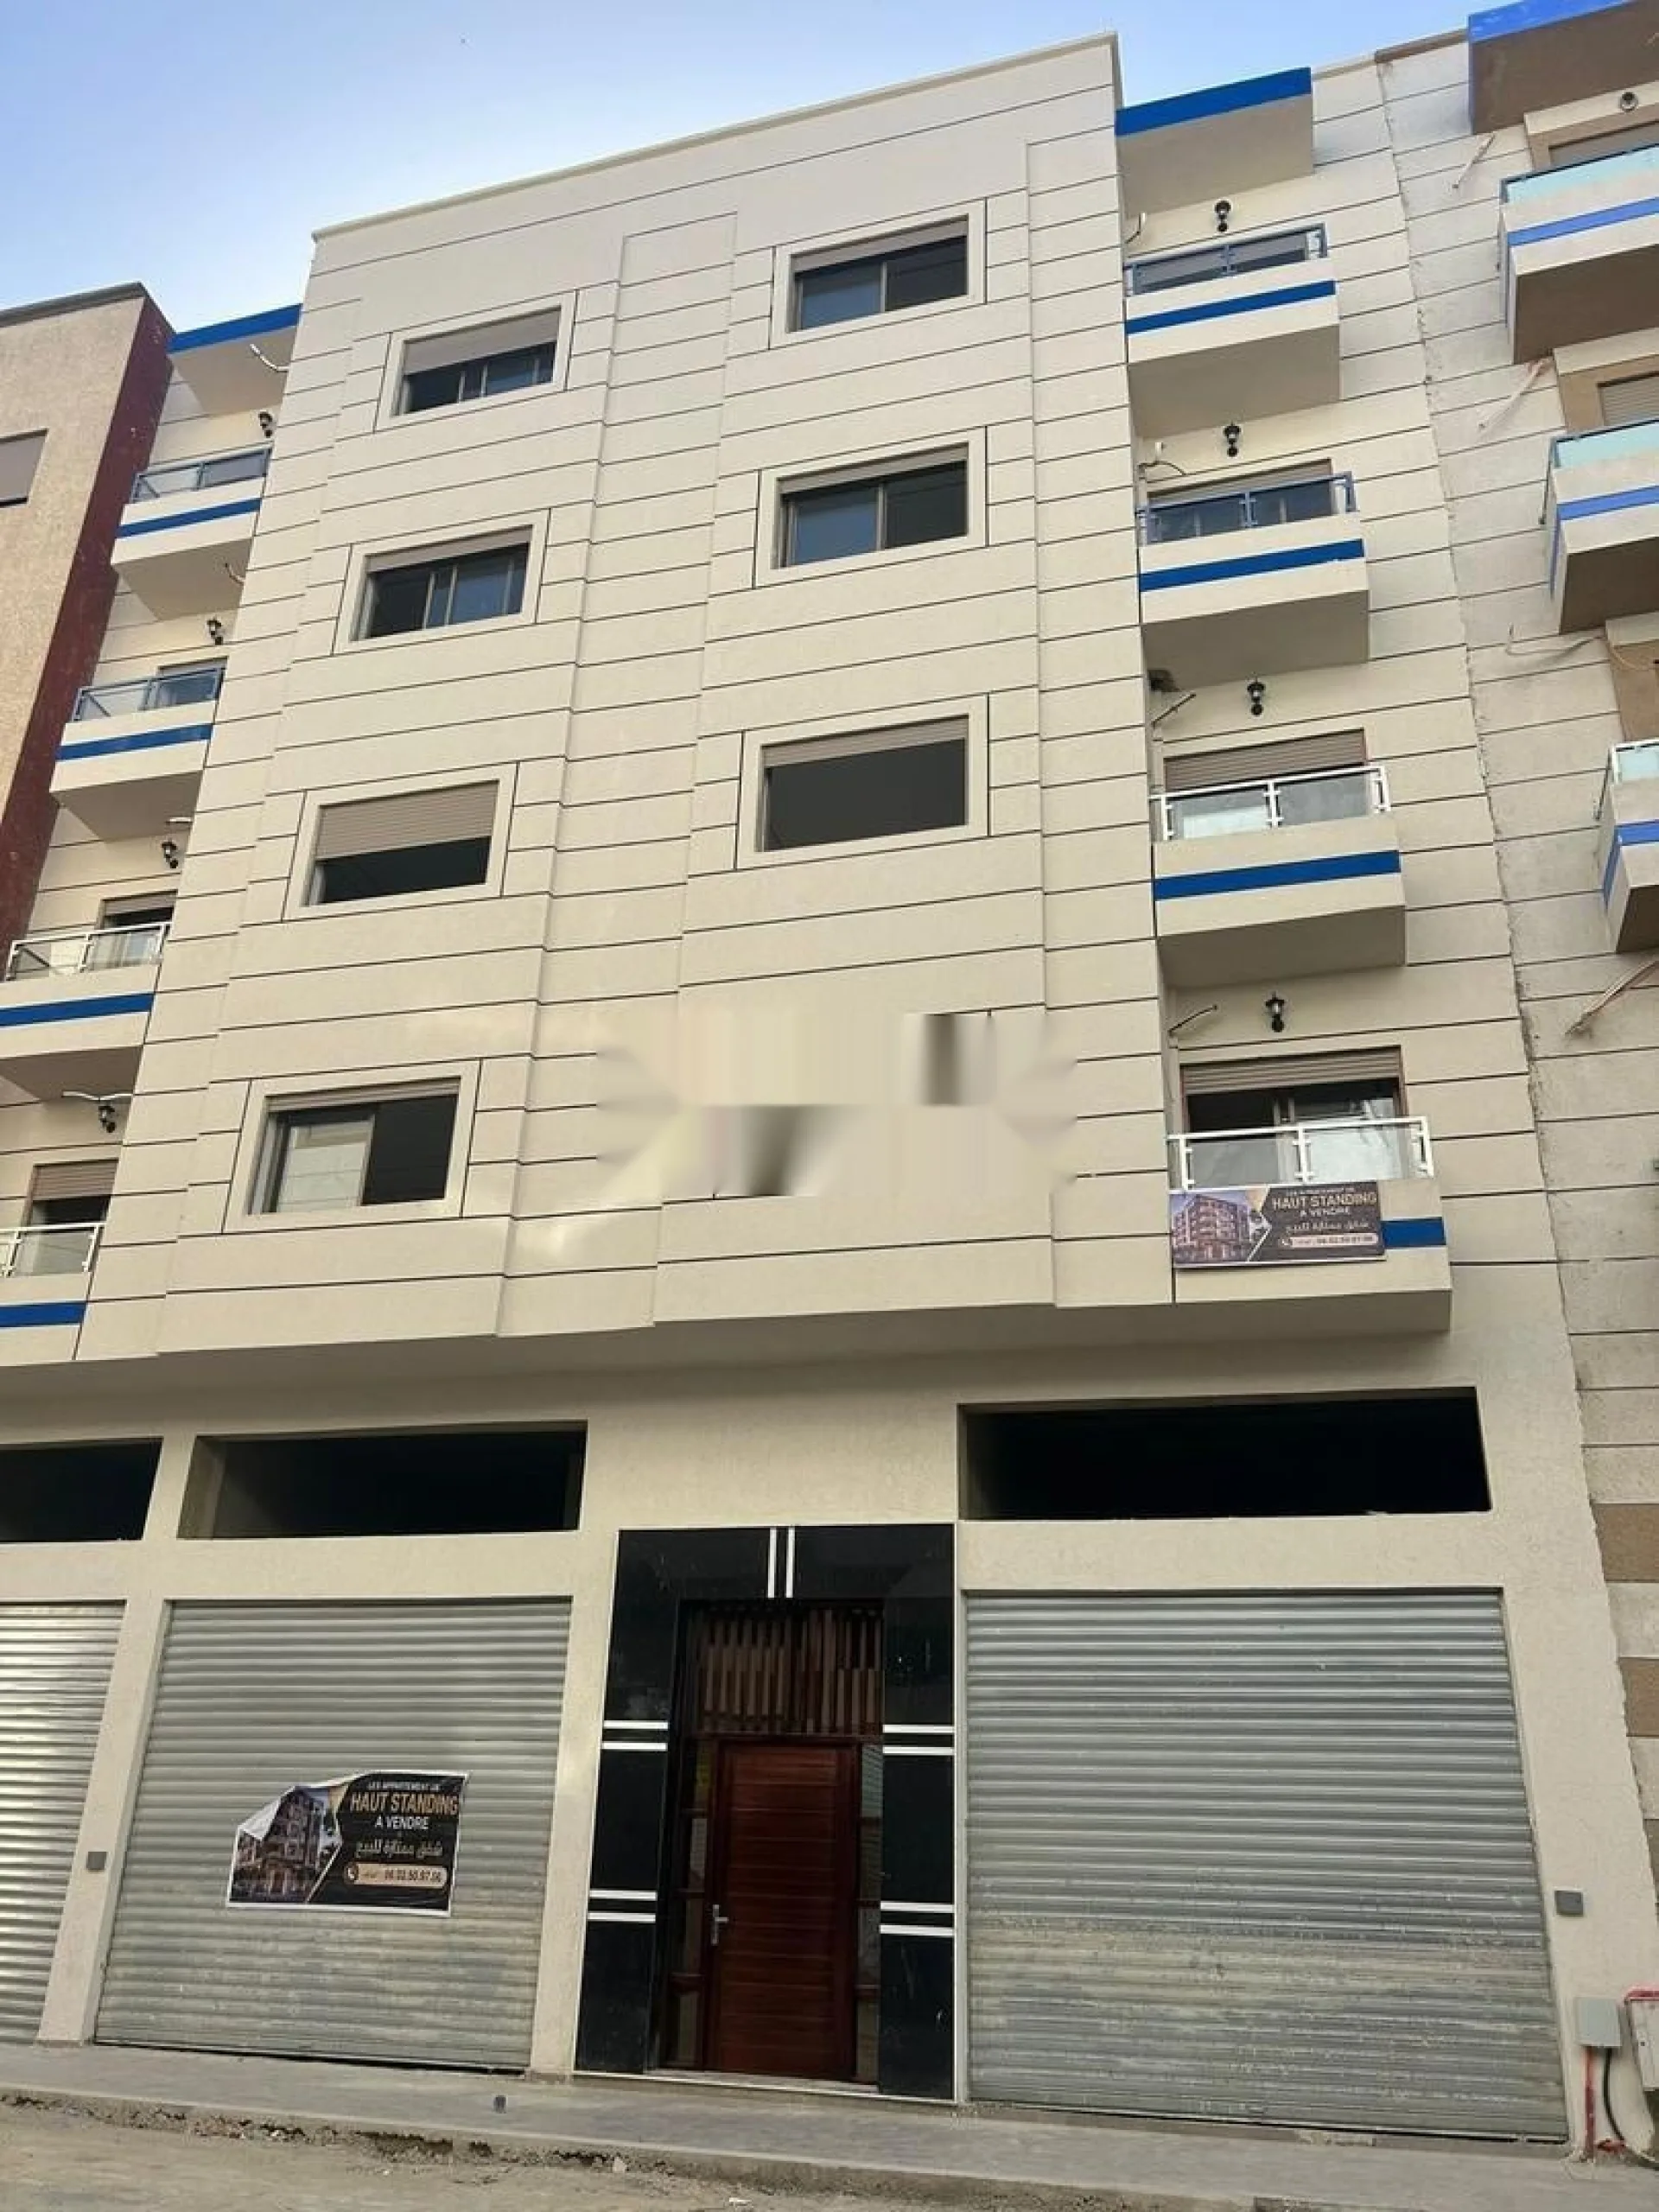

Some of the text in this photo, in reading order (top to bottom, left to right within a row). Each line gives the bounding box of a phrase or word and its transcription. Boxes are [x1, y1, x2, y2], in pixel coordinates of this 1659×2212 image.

[1271, 1192, 1377, 1211] HAUT STANDING
[350, 1791, 459, 1815] HAUT STANDING
[385, 1816, 429, 1830] VENDRE
